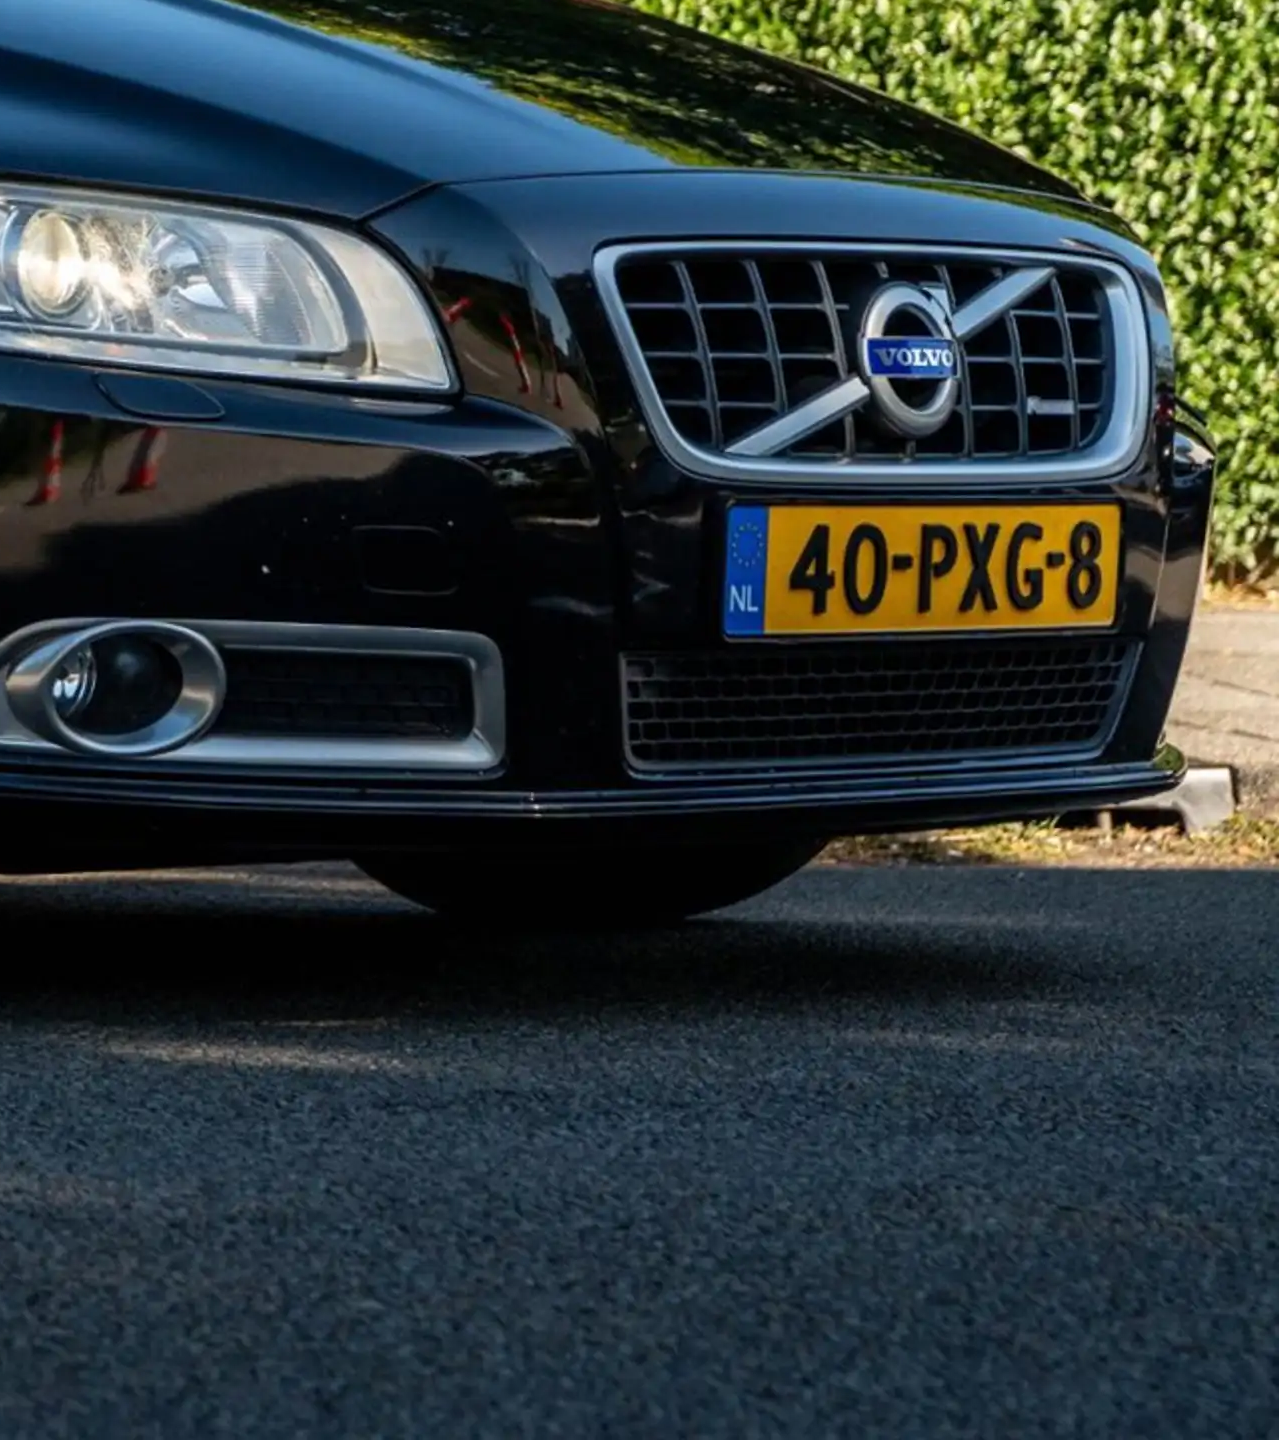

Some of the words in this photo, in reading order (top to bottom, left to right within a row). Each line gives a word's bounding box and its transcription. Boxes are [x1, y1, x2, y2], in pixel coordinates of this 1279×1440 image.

[873, 347, 954, 368] VOLVO
[789, 521, 1103, 616] 40-PXG-8
[729, 585, 759, 613] NL
